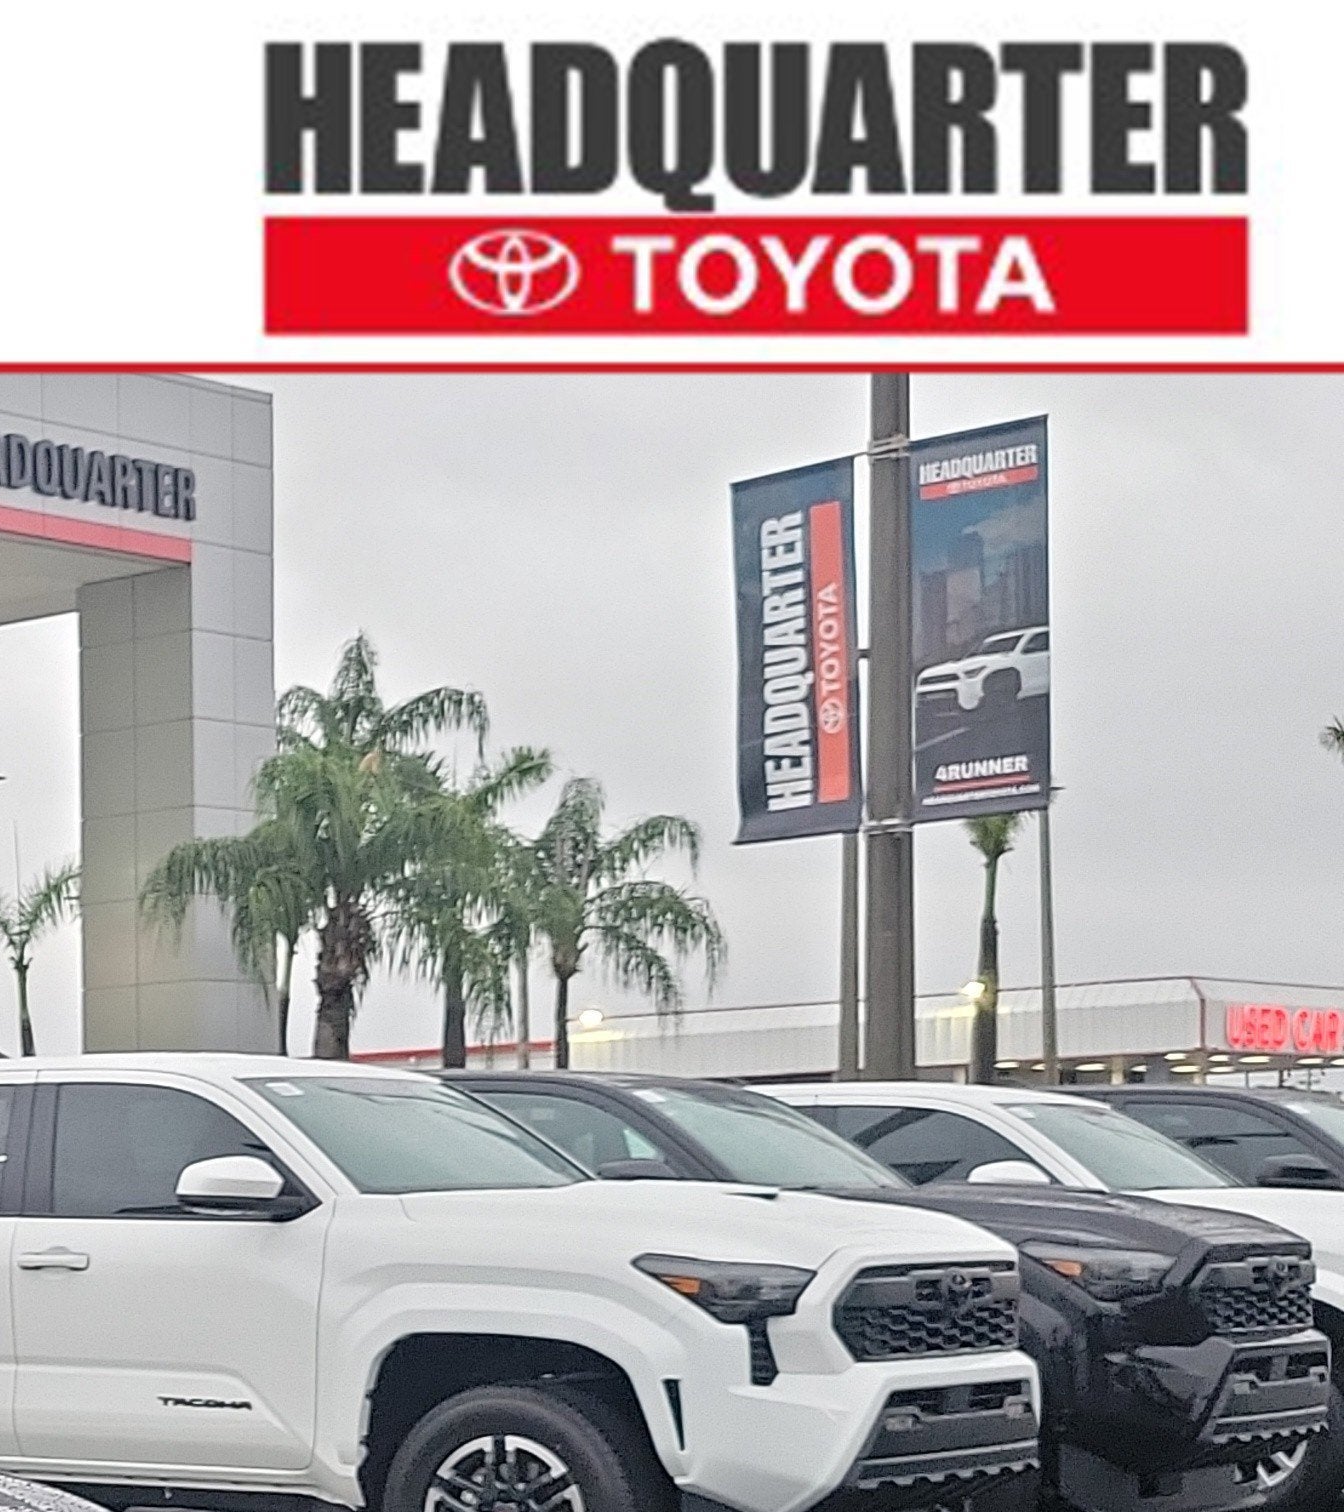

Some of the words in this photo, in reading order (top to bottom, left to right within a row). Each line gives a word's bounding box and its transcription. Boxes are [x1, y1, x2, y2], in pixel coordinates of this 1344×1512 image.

[918, 443, 1038, 485] HEADQUARTER
[817, 582, 842, 696] TOYOTA
[761, 510, 814, 812] HEADQUARTER
[934, 754, 1029, 782] 4RUNNER
[1226, 1005, 1288, 1049] USED
[157, 1396, 253, 1411] TACOMA
